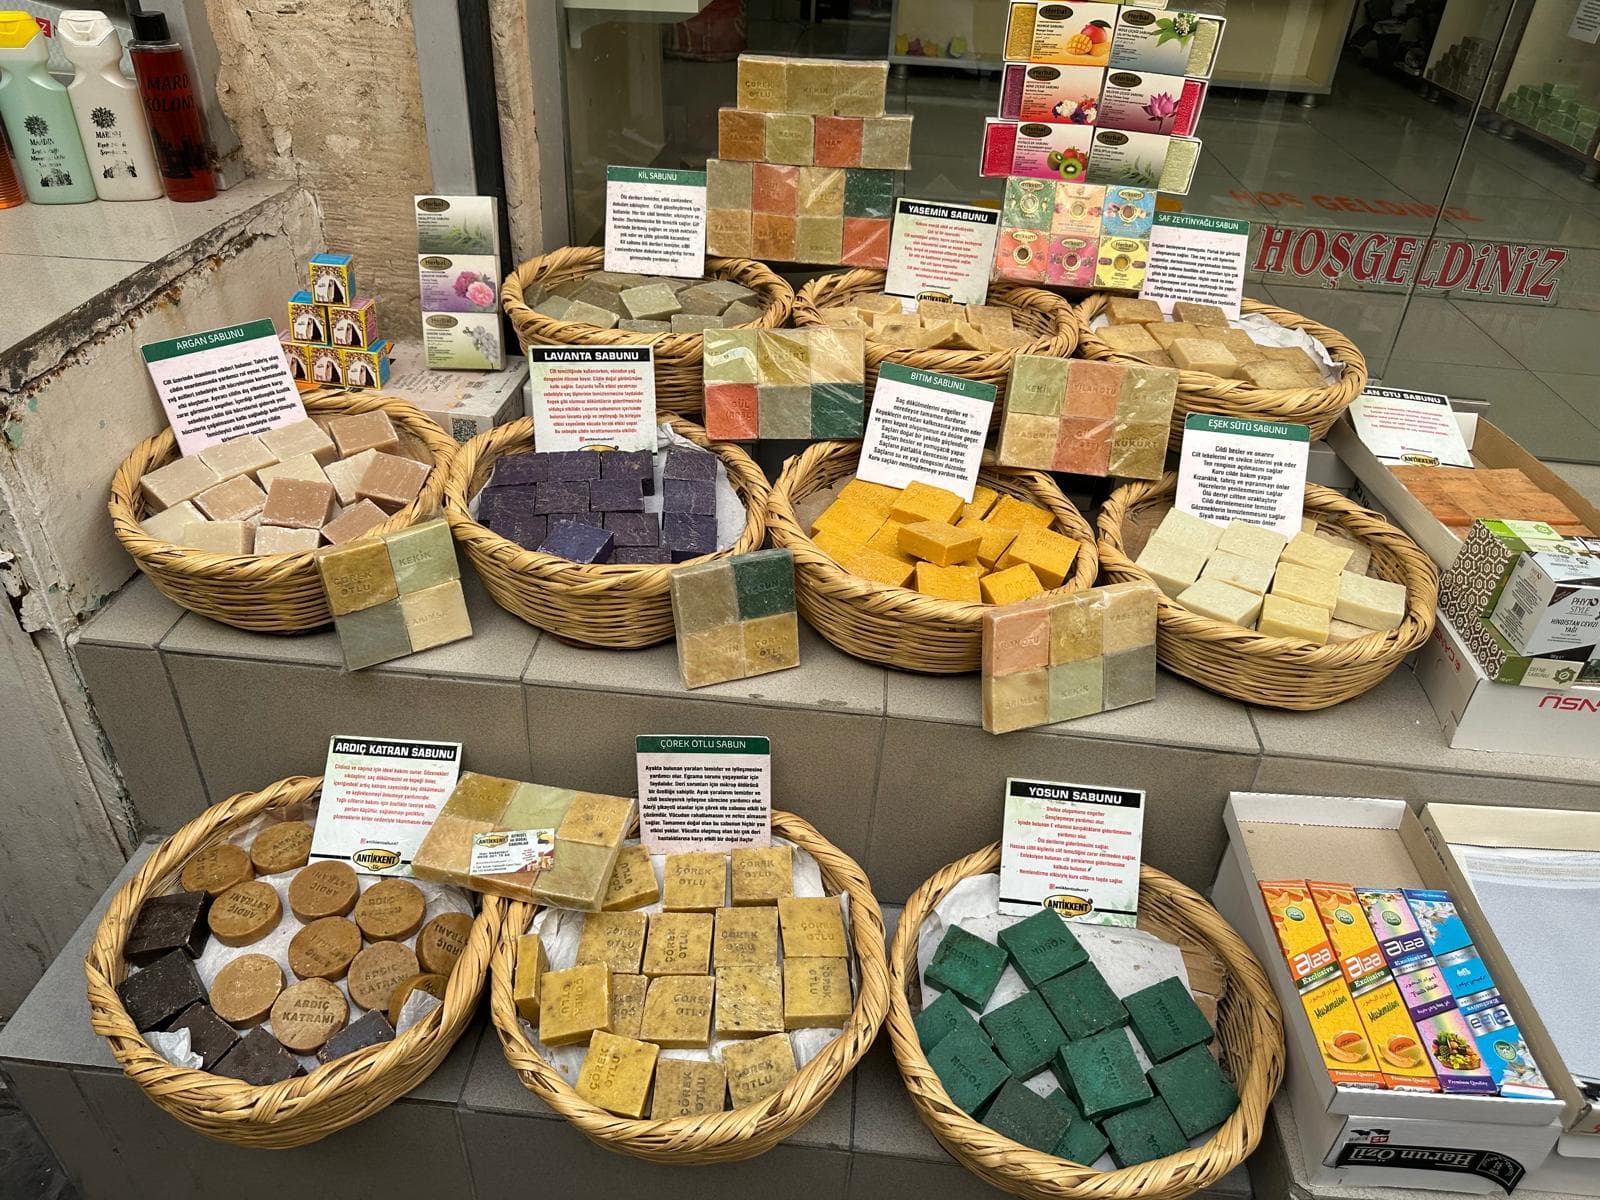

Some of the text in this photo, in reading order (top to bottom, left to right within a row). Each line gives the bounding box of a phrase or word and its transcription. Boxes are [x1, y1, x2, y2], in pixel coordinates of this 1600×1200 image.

[147, 74, 190, 91] MARD
[908, 206, 988, 222] YASEMİN SABUNU
[1158, 214, 1170, 222] SAF
[1215, 221, 1240, 230] SABUN
[176, 329, 244, 350] ARGAN SABUNU
[544, 352, 639, 360] LAVANTA SABUNU
[933, 377, 966, 390] SABUNU
[1383, 390, 1400, 398] OTU
[1403, 394, 1441, 403] SABUNU
[893, 405, 918, 414] neredeyse
[920, 410, 943, 419] tamamen
[899, 429, 914, 437] doğal
[1208, 419, 1287, 434] EŞEK SÜTÜ SABUNU
[899, 436, 915, 444] besler
[335, 742, 454, 759] ARDIÇ KATRAN SABUNU
[660, 740, 746, 749] ÇÖREK OTLU SABUN
[1029, 787, 1122, 804] YOSUN SABUNU
[356, 853, 396, 864] ANTİKKENT
[1047, 899, 1089, 912] ANTİKKENT
[1301, 965, 1334, 985] Exclusive
[1354, 970, 1385, 988] Exclusive
[294, 1000, 330, 1011] ARDIÇ
[282, 1011, 335, 1024] KATRANI
[1347, 1148, 1476, 1166] Harun Özil
